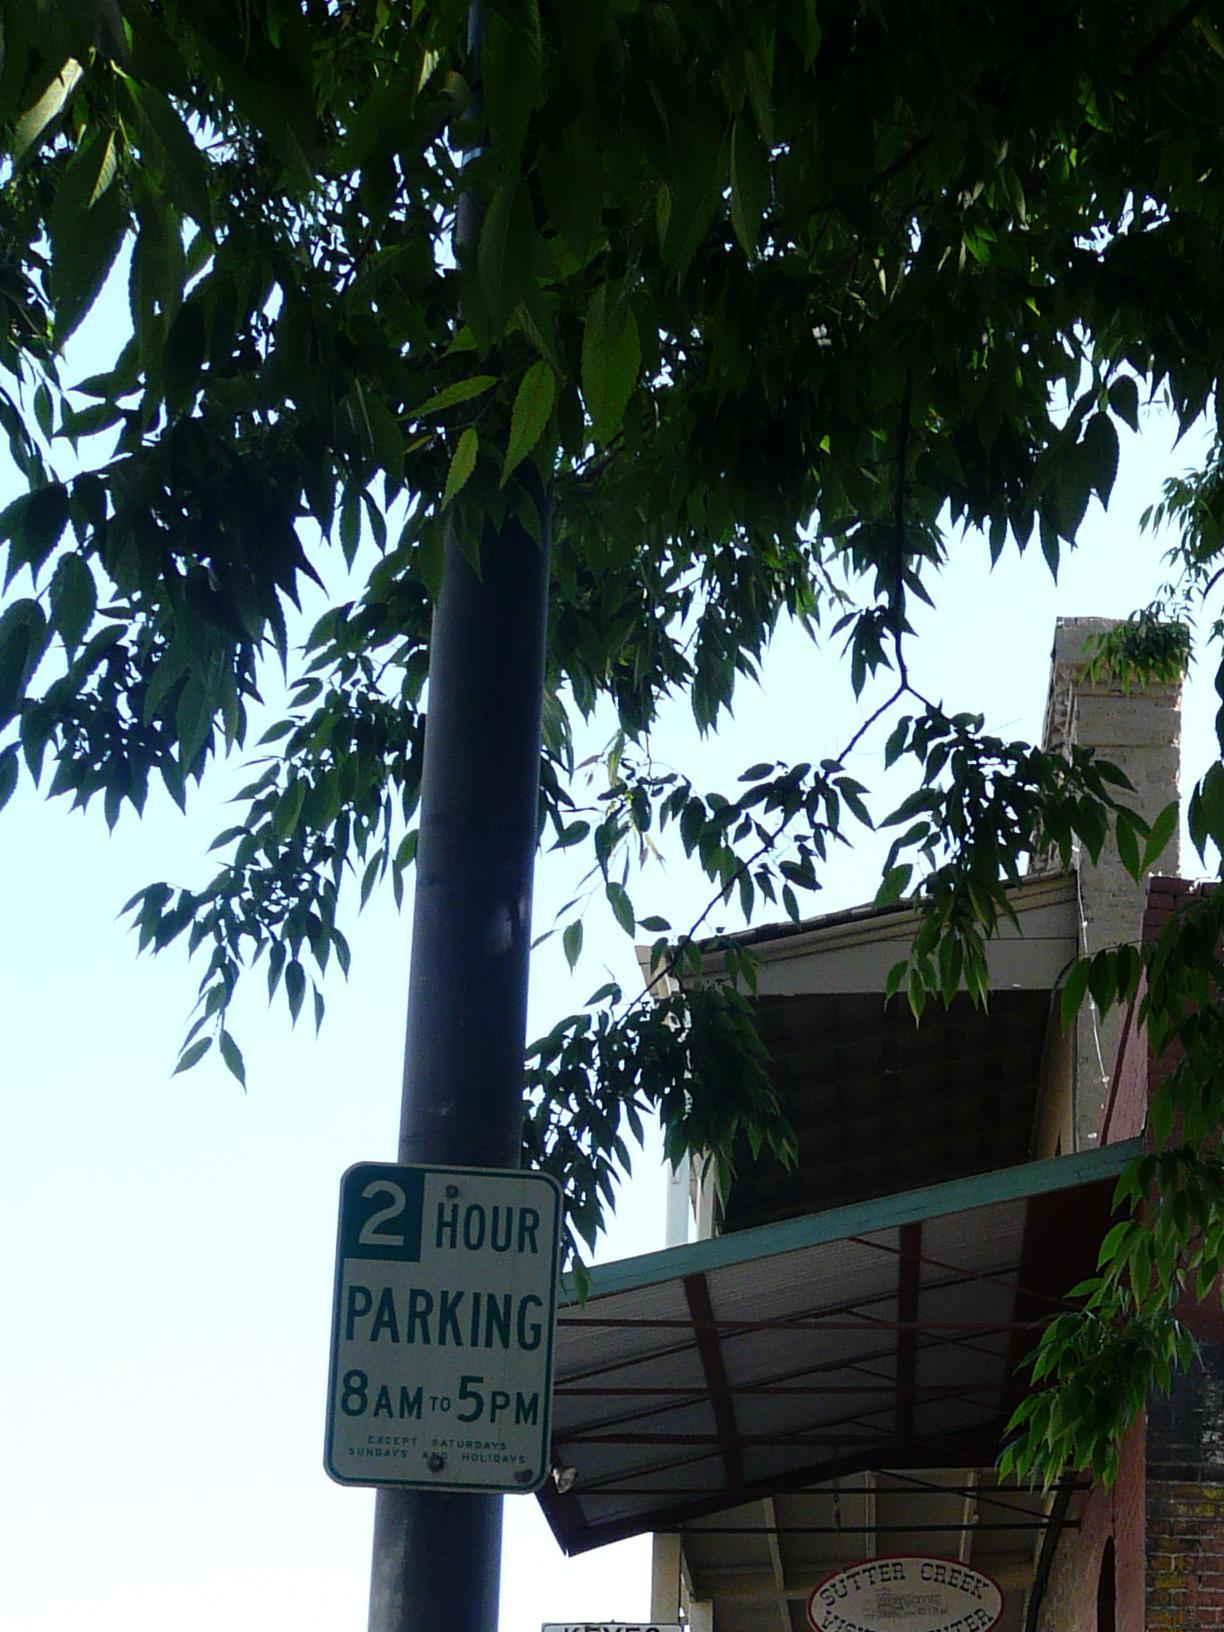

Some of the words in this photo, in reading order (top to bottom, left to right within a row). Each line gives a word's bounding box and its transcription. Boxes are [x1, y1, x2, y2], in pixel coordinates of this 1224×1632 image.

[358, 1179, 406, 1247] 2
[435, 1202, 540, 1253] HOUR
[344, 1284, 544, 1351] PARKING
[340, 1368, 423, 1421] 8AM
[429, 1395, 452, 1413] TO
[456, 1374, 540, 1426] 5PM
[348, 1448, 408, 1458] SUNDAYS
[421, 1452, 448, 1461] AND
[461, 1453, 526, 1464] HOLIDAYS
[367, 1435, 417, 1447] EXCEPT
[431, 1438, 507, 1451] SATURDAYS
[819, 1561, 906, 1607] SUTTER
[920, 1561, 989, 1600] CREEK
